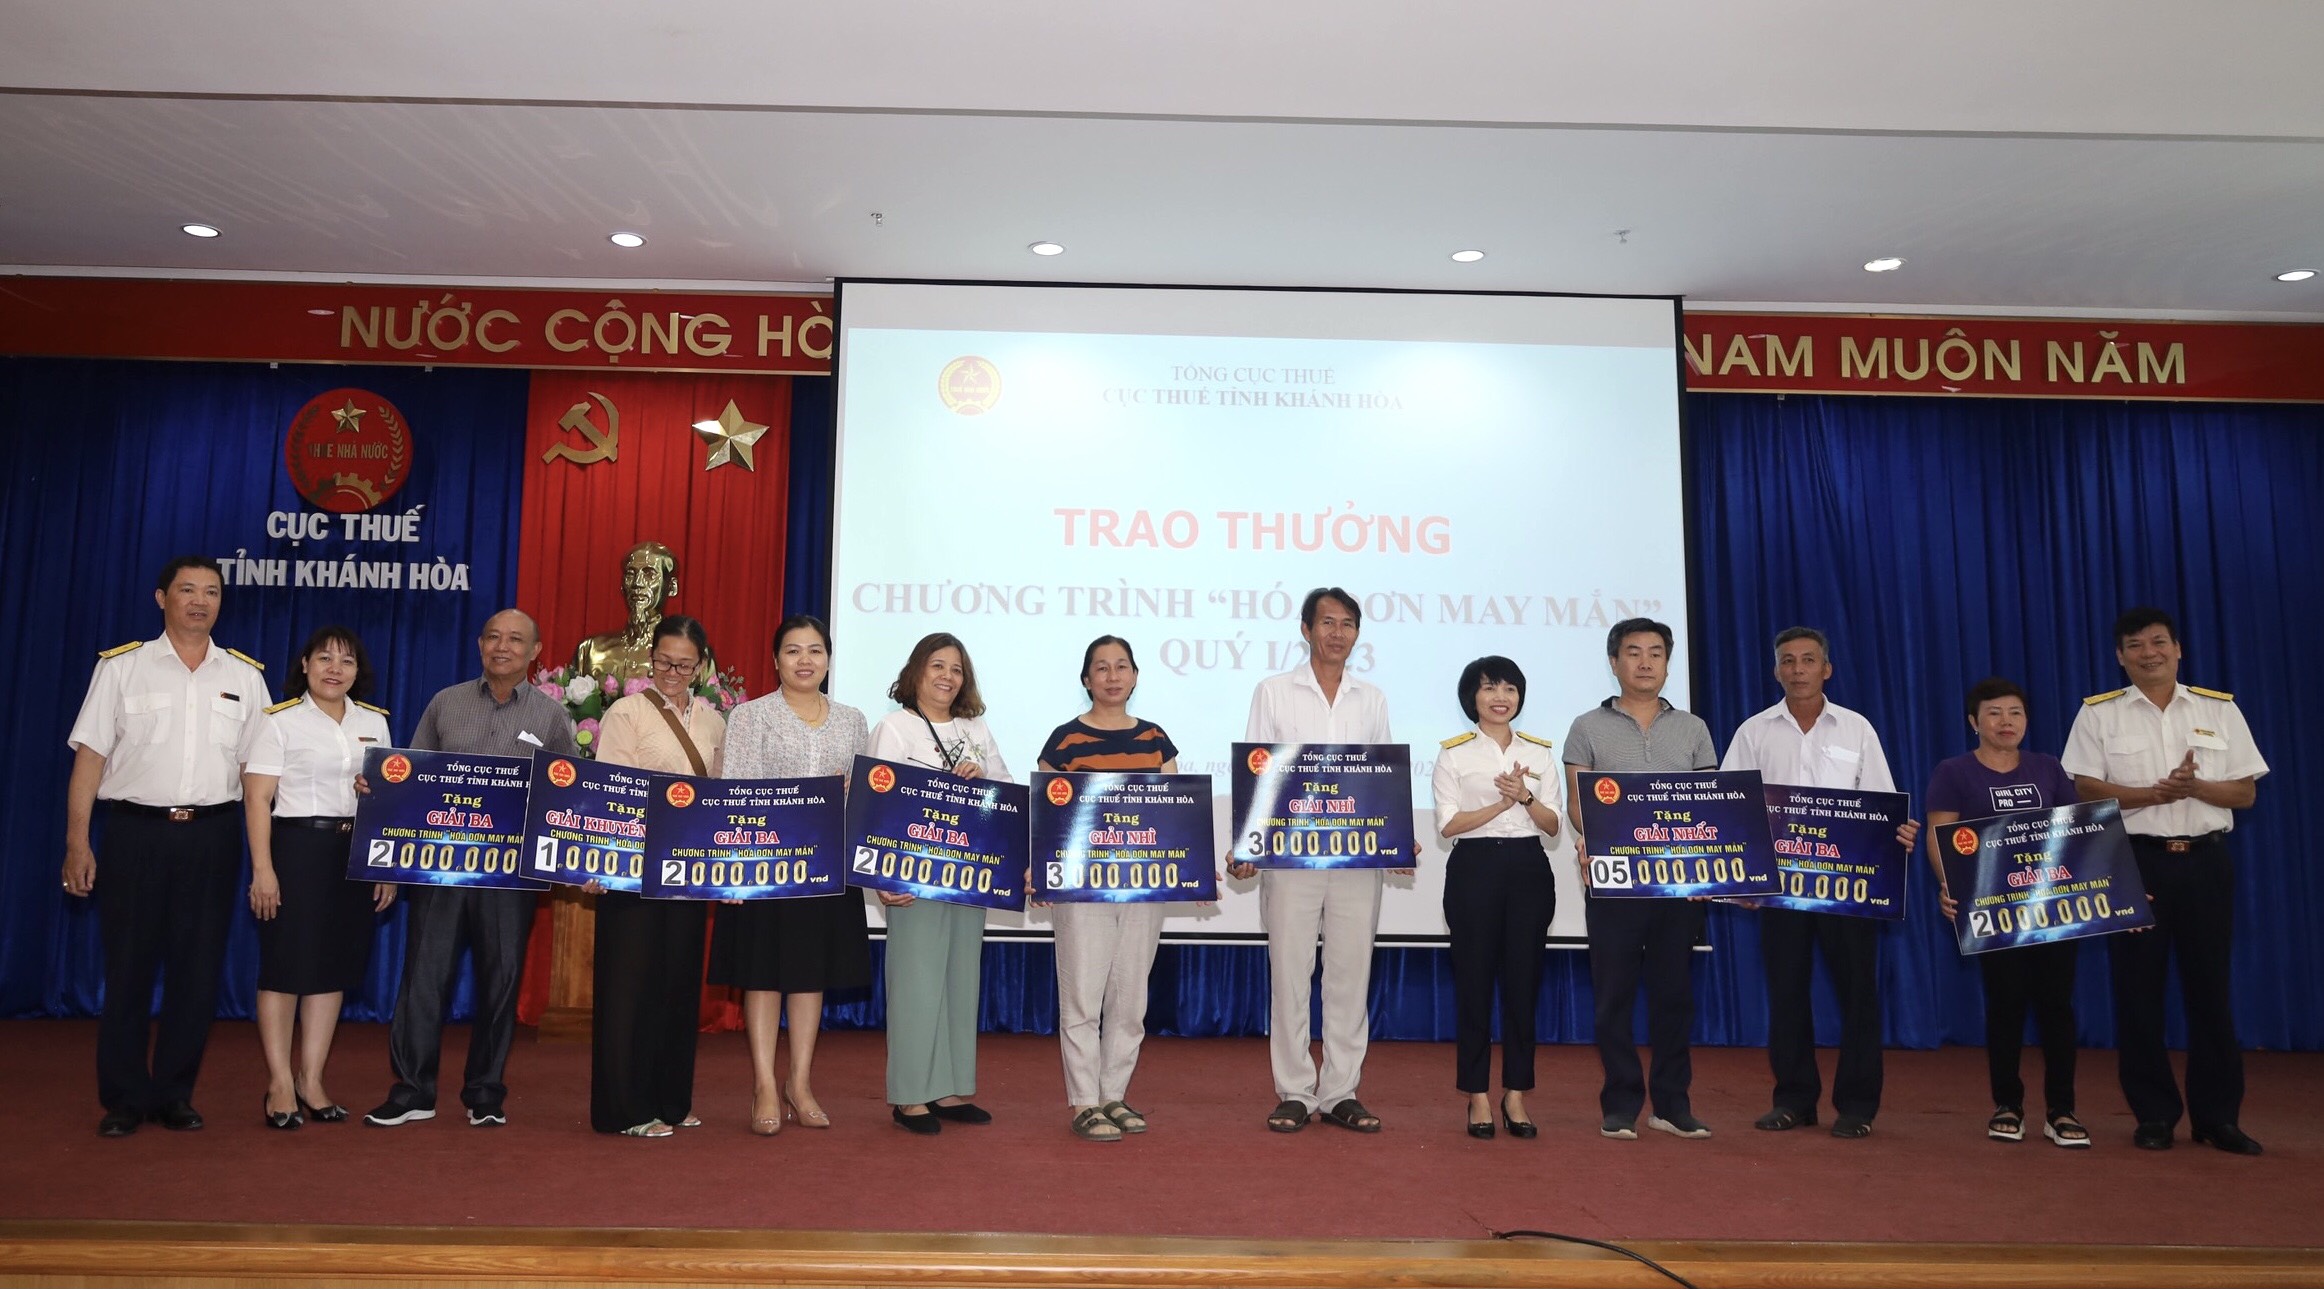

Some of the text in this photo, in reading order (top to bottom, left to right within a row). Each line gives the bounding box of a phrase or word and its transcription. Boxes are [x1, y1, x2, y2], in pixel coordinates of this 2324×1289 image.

[340, 293, 521, 352] NƯỚC
[545, 299, 732, 363] CỘNG
[1841, 327, 2022, 382] MUÔN
[2047, 330, 2186, 384] NĂM
[1234, 368, 1275, 386] CỤC
[1281, 367, 1336, 385] THUẾ
[1102, 386, 1403, 410] CỤC THUẾ TỈNH KHÁNH HÒA
[267, 504, 426, 546] CỤC THUẾ
[1054, 500, 1450, 555] TRAO THƯỞNG
[216, 548, 470, 591] TỈNH KHÁNH HÒA
[852, 579, 1046, 616] CHƯƠNG
[1058, 577, 1194, 618] TRÌNH
[1208, 581, 1302, 620] “HÓ
[1352, 590, 1424, 623] ƠN
[1438, 596, 1534, 626] MAY
[1159, 630, 1254, 674] QUÝ
[1302, 752, 1367, 763] TỔNG CỤC THUẾ
[447, 761, 520, 775] TỔNG CỤC THUẾ
[1279, 763, 1392, 774] CỤC THUẾ TỈNH KHÁNH HÒA
[418, 774, 436, 783] CỤC
[440, 774, 464, 784] THUẾ
[467, 775, 488, 785] TỈNH
[491, 777, 522, 788] KHÁNH
[609, 772, 632, 784] TỔNG
[1650, 779, 1718, 790] TỔNG CỤC THUẾ
[583, 781, 626, 794] CỤC THUẾ
[729, 785, 799, 797] TỔNG CỤC THUẾ
[927, 778, 970, 794] TỔNG CỤC
[1128, 782, 1169, 793] CỤC THUẾ
[1303, 782, 1339, 794] Tặng
[2014, 788, 2032, 796] CITY
[442, 794, 482, 808] Tặng
[702, 799, 720, 807] CỤC
[723, 797, 747, 806] THUẾ
[750, 798, 770, 806] TỈNH
[773, 797, 804, 805] KHÁNH
[901, 786, 1019, 813] CỤC THUẾ TỈNH KHÁNH HÒA
[1079, 794, 1194, 804] CỤC THUẾ TỈNH KHÁNH HÒA
[1627, 791, 1745, 802] CỤC THUẾ TỈNH KHÁNH HÒA
[1789, 793, 1861, 808] TỔNG CỤC THUẾ
[1998, 799, 2014, 807] PRO
[607, 802, 645, 818] Tặng
[1289, 796, 1355, 813] GIẢI NHÌ
[427, 807, 493, 828] GIẢI BA
[546, 809, 580, 829] GIẢI
[922, 808, 960, 825] Tặng
[1103, 813, 1140, 825] Tặng
[1654, 811, 1692, 822] Tặng
[1783, 805, 1888, 821] THUẾ TỈNH KHÁNH HÒA
[727, 815, 766, 827] Tặng
[1350, 818, 1365, 827] MAY
[2031, 821, 2049, 830] CỤC
[714, 827, 779, 844] GIẢI BA
[907, 822, 969, 846] GIẢI BA
[1089, 826, 1156, 845] GIẢI NHÌ
[1634, 821, 1718, 841] GIẢI NHẤT
[1788, 823, 1827, 838] Tặng
[1986, 839, 2003, 849] CỤC
[2004, 833, 2027, 845] THUẾ
[2029, 830, 2050, 841] TỈNH
[2086, 824, 2105, 833] HÒA
[489, 835, 505, 843] MAY
[776, 848, 792, 856] MAY
[1150, 850, 1165, 858] MAY
[1380, 847, 1398, 855] vnd
[1707, 845, 1722, 853] MAY
[1775, 836, 1840, 858] GIẢI BA
[964, 852, 980, 862] MAY
[2014, 852, 2053, 865] Tặng
[1836, 864, 1853, 872] MAY
[810, 875, 828, 883] vnd
[2008, 865, 2072, 887] GIẢI BA
[2071, 882, 2088, 893] MAY
